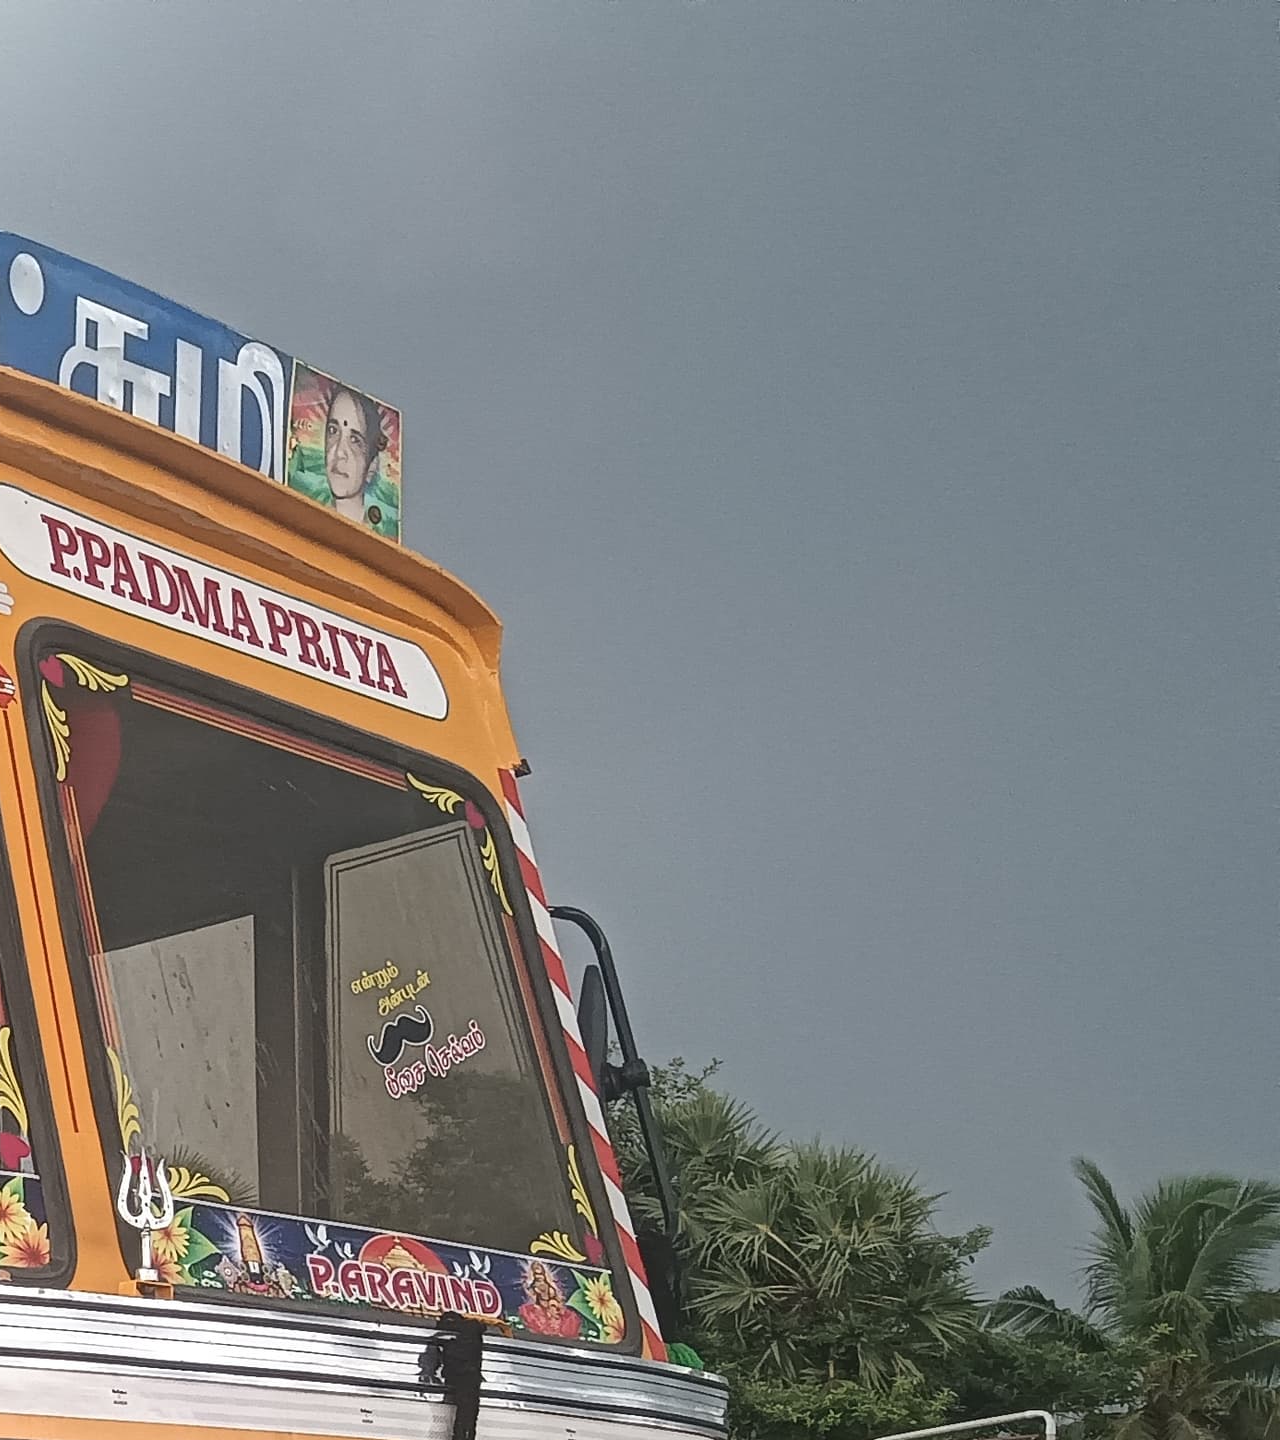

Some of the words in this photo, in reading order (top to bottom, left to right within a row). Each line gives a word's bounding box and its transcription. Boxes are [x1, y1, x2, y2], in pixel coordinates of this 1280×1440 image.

[350, 960, 399, 994] என்றும்
[378, 969, 431, 1016] அன்புடன்
[425, 1020, 486, 1078] செல்வம்
[306, 1253, 503, 1318] P.ARAVIND
